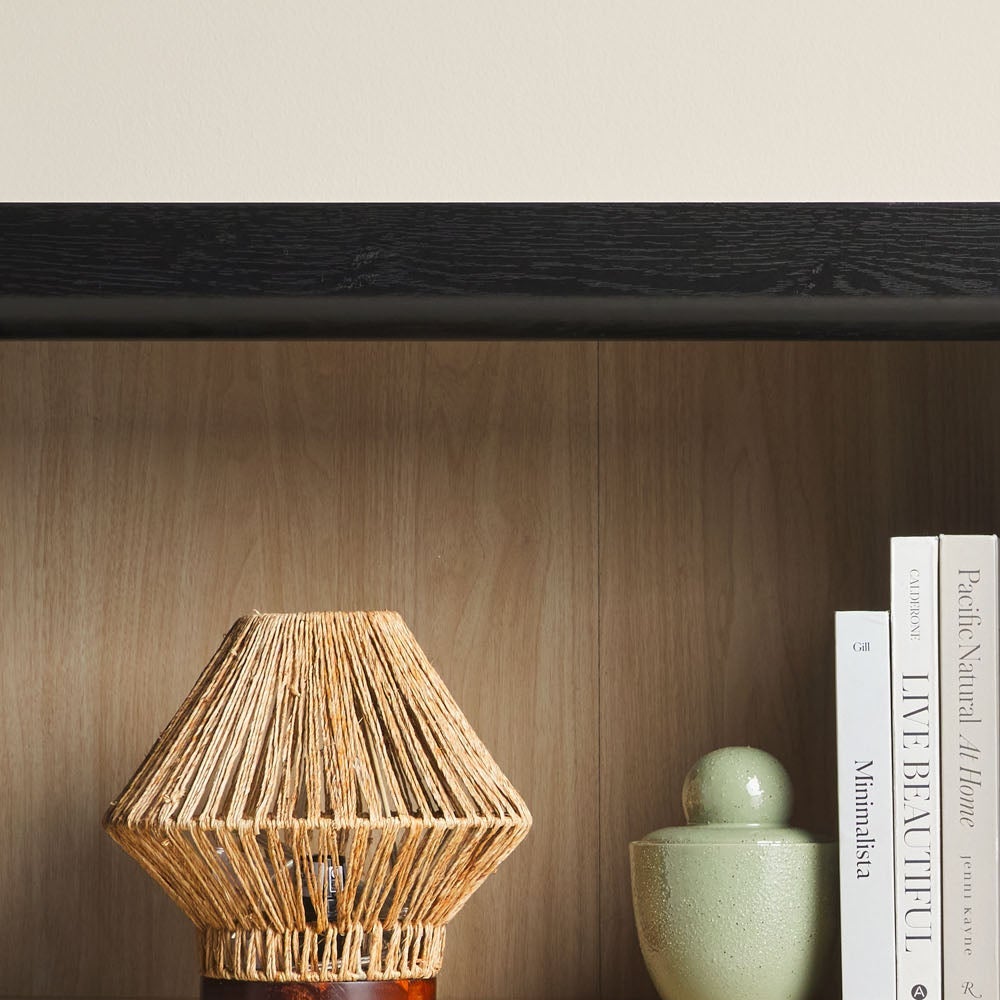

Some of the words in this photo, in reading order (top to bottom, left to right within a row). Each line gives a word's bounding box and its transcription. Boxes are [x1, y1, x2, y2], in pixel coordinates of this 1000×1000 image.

[909, 568, 920, 641] CALDERONE
[958, 569, 981, 640] Pacific
[852, 641, 870, 652] Gill
[902, 672, 930, 749] LIVE
[958, 644, 982, 723] Natural
[959, 735, 982, 761] At
[854, 760, 876, 879] Minimalista
[959, 765, 982, 828] Home
[903, 760, 932, 953] BEAUTIFUL
